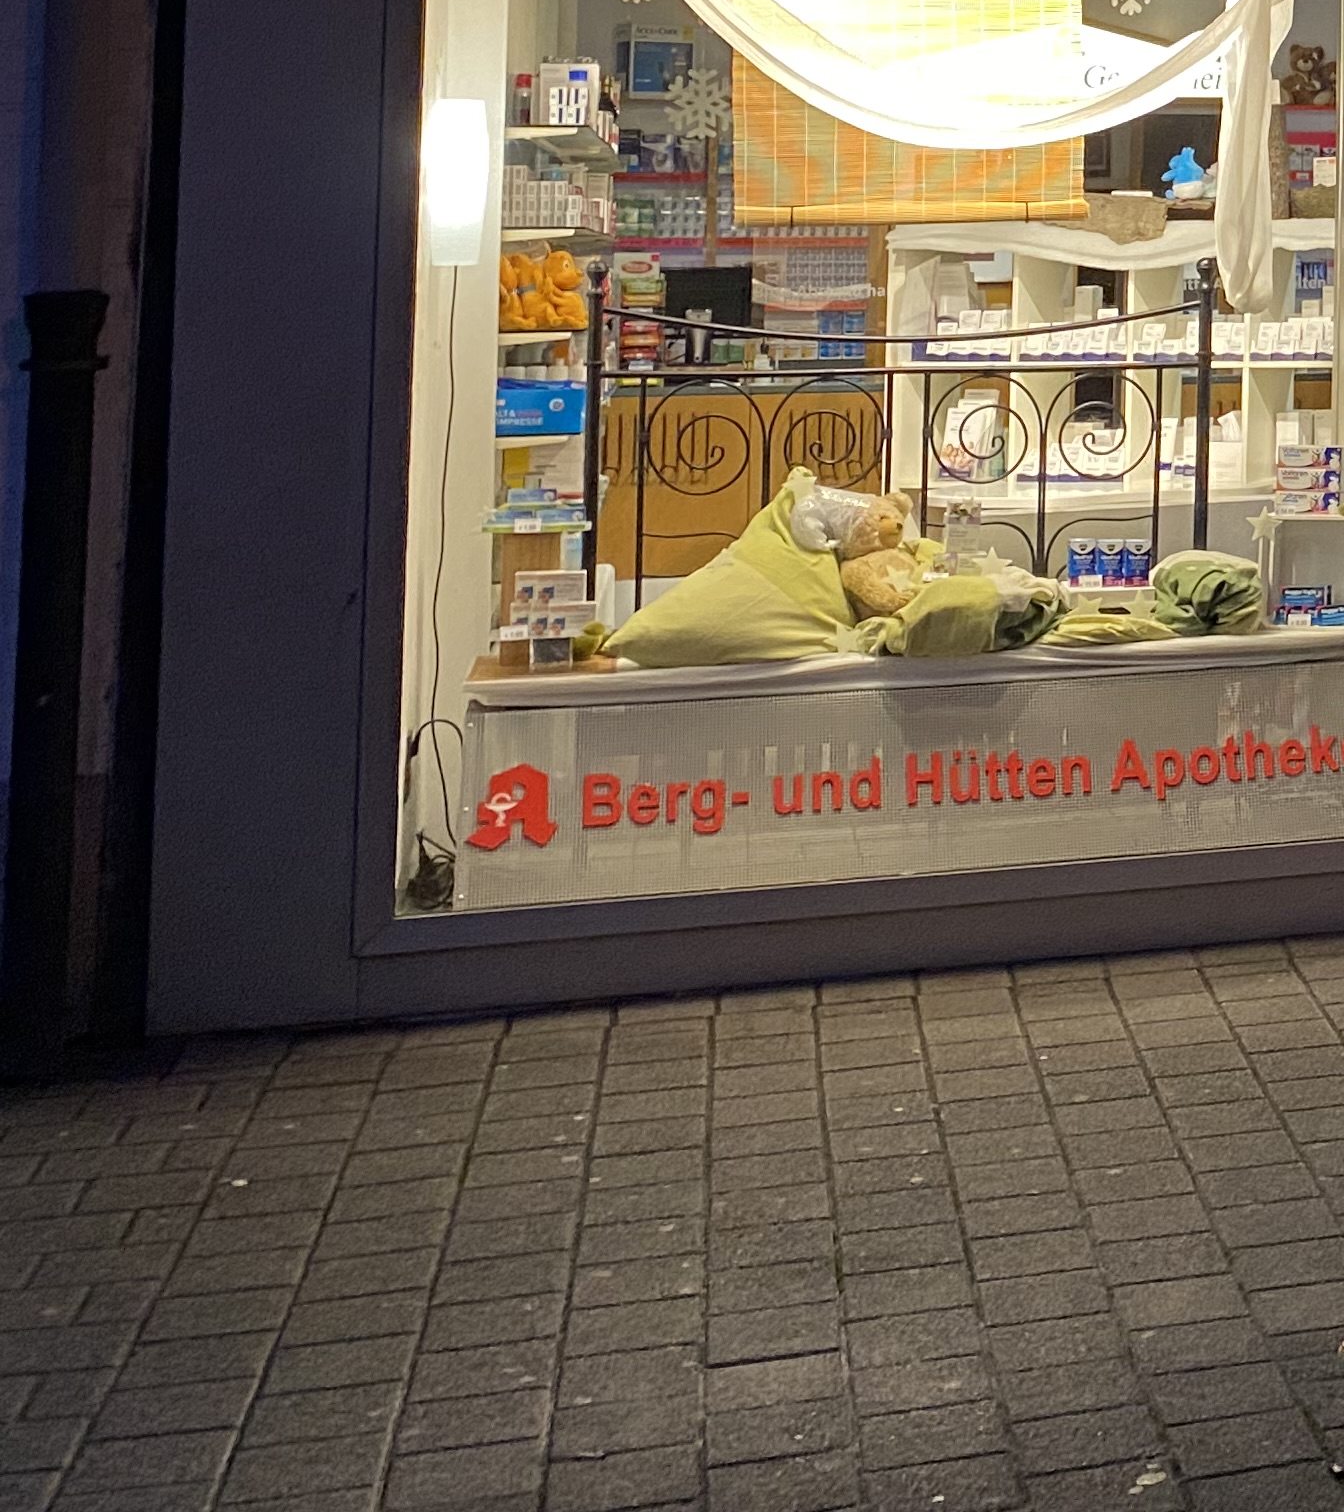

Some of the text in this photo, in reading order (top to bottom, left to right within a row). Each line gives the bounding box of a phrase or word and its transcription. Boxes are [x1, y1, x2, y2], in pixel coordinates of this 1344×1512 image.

[582, 772, 750, 834] Berg-
[773, 755, 883, 815] und
[905, 747, 1094, 807] Hütten
